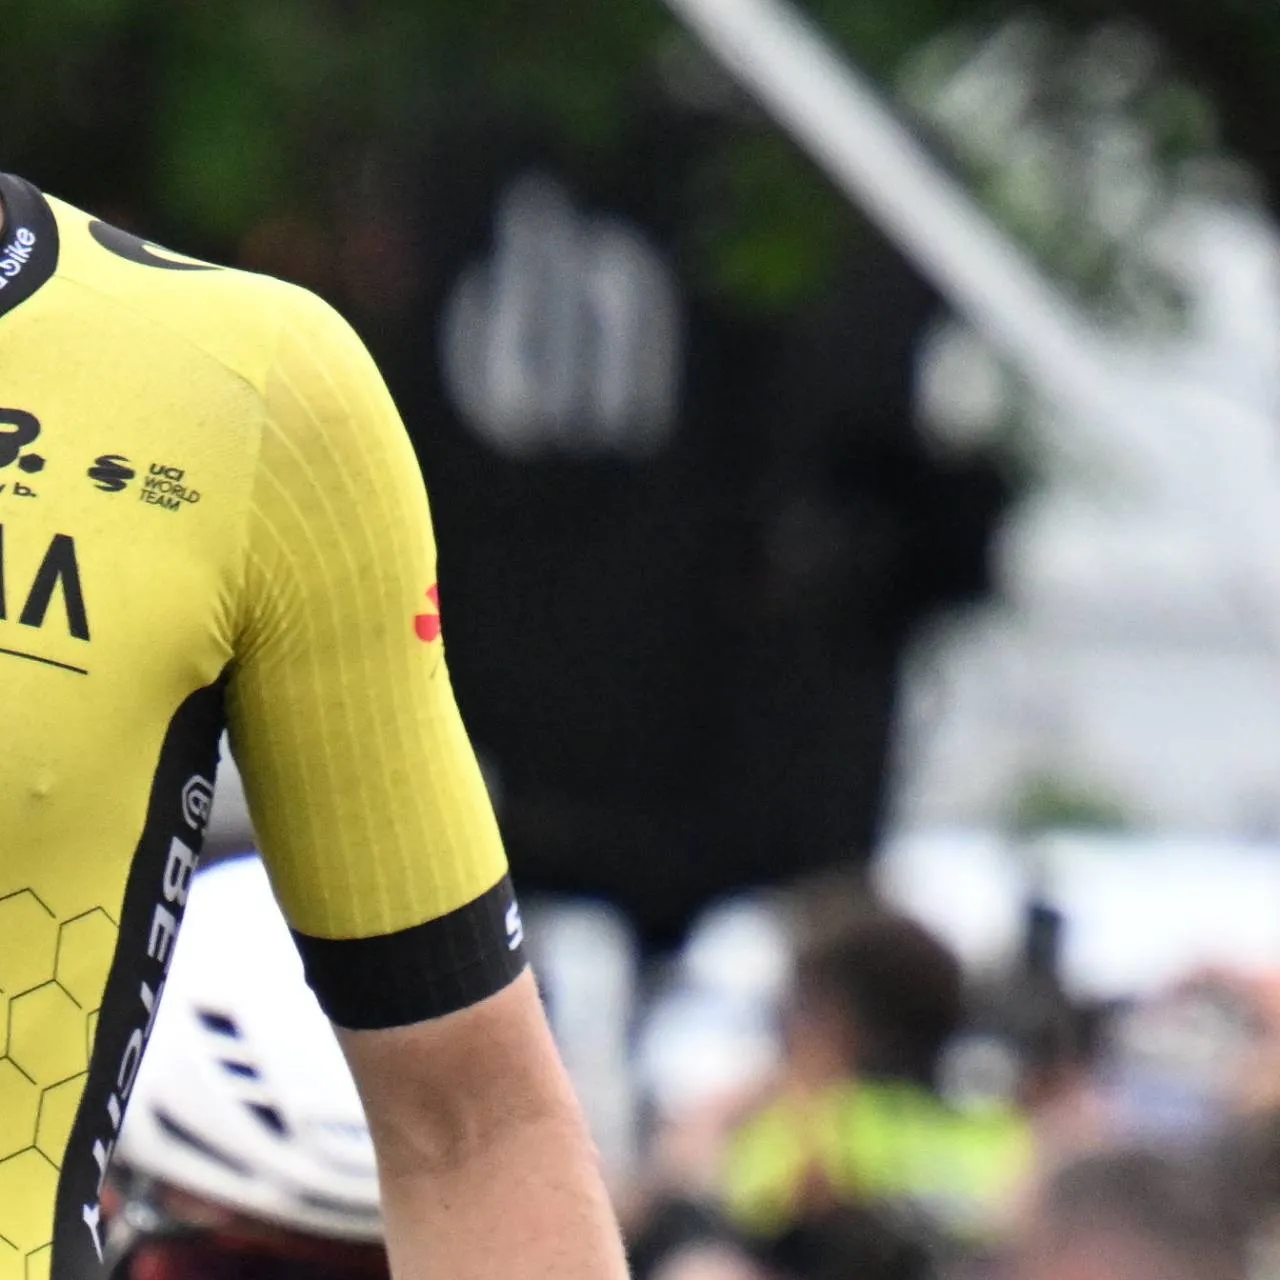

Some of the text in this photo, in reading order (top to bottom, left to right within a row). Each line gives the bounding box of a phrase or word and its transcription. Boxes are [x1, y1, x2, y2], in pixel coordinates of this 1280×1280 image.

[149, 463, 185, 482] UCI
[140, 488, 181, 512] TEAM
[144, 475, 201, 504] WORLD
